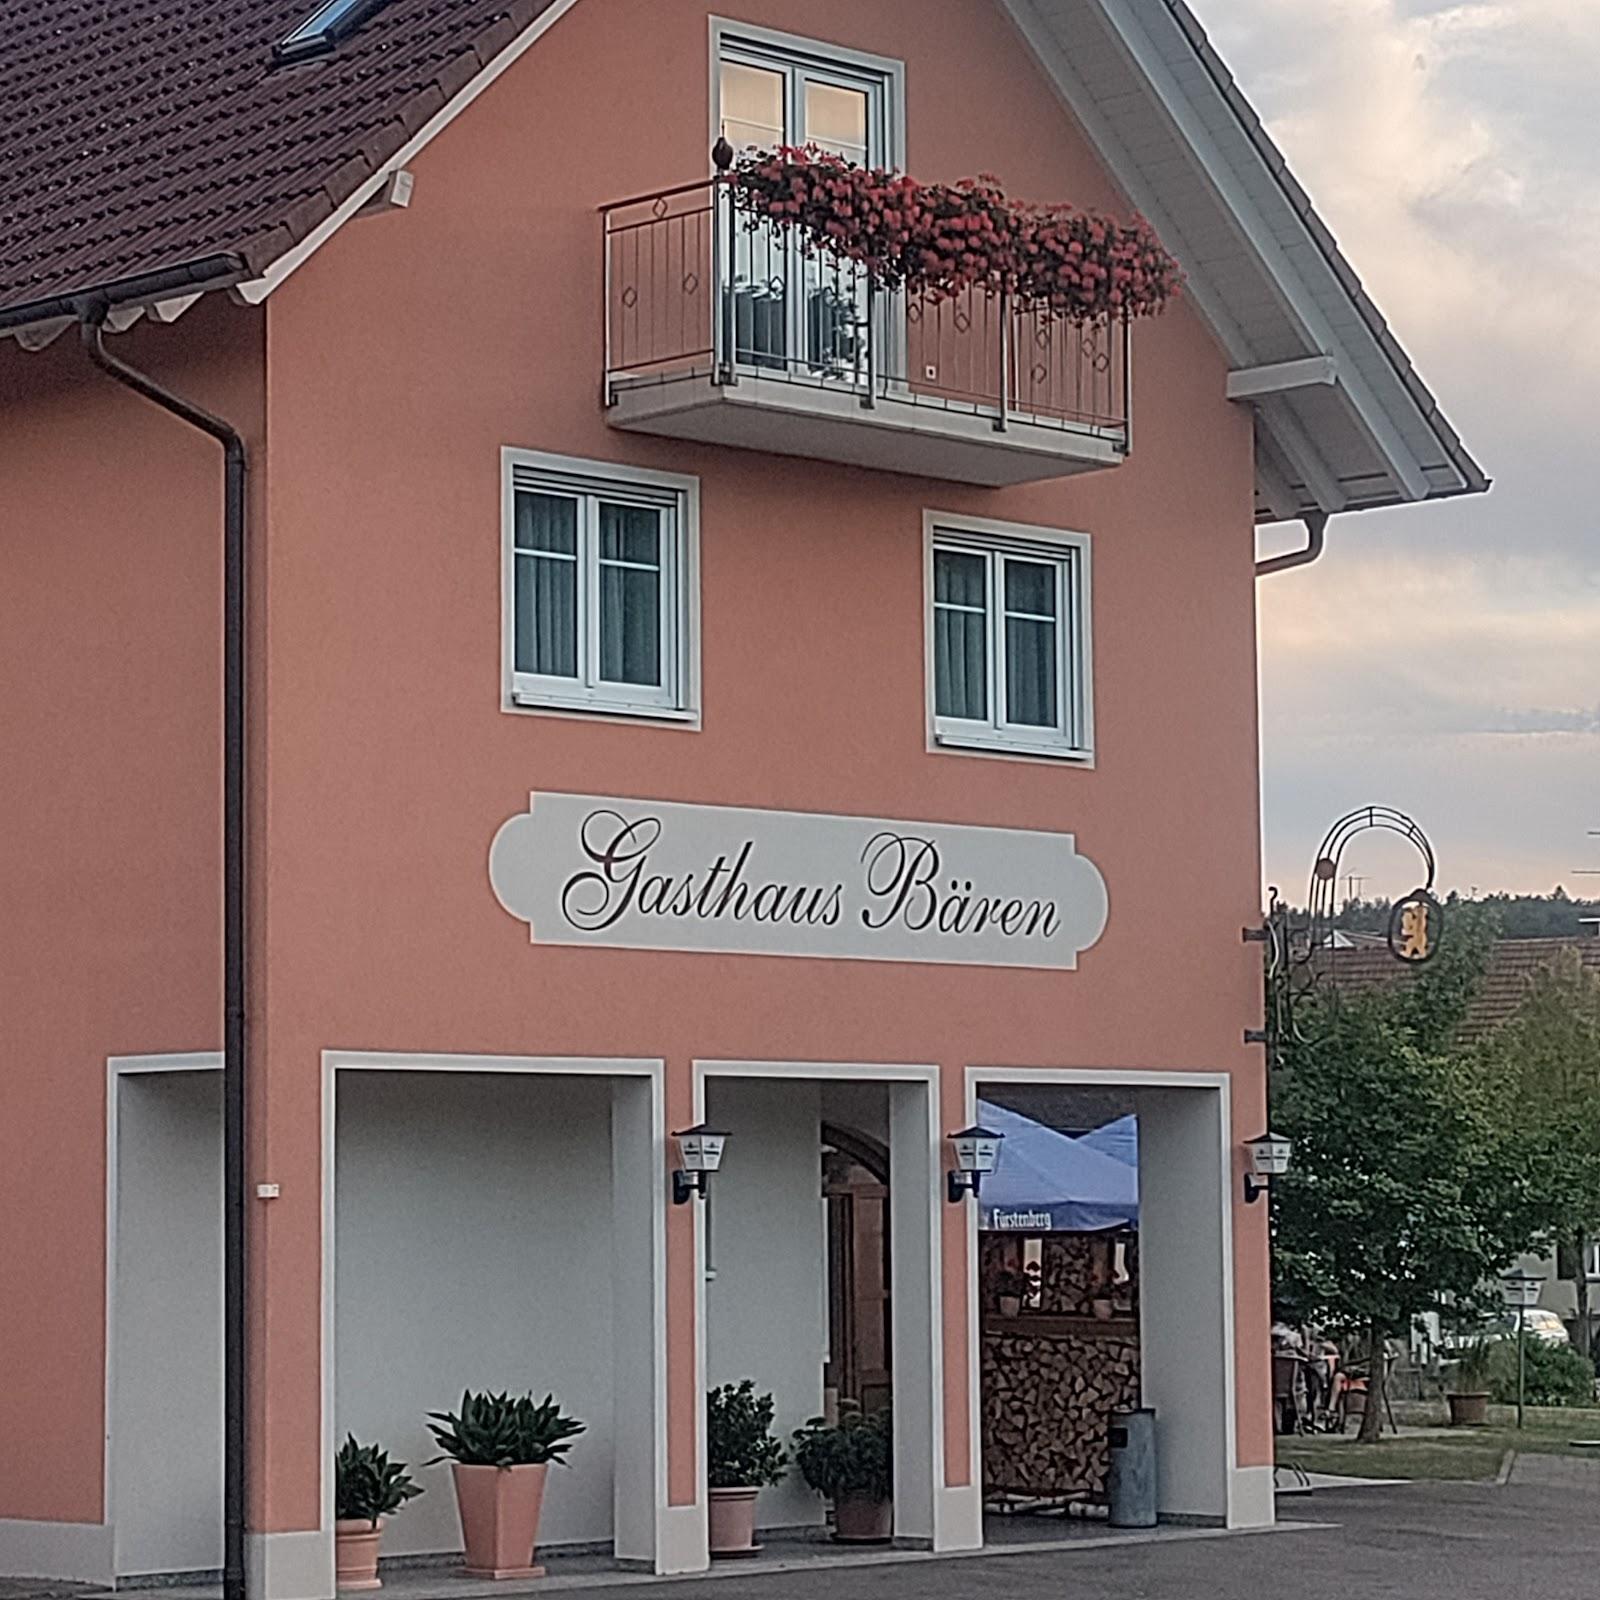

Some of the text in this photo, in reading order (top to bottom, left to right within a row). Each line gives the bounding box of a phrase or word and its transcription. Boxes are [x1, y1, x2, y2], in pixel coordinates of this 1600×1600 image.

[562, 810, 1061, 938] Gasthaus Bären
[993, 1208, 1052, 1230] Fürstenberg
